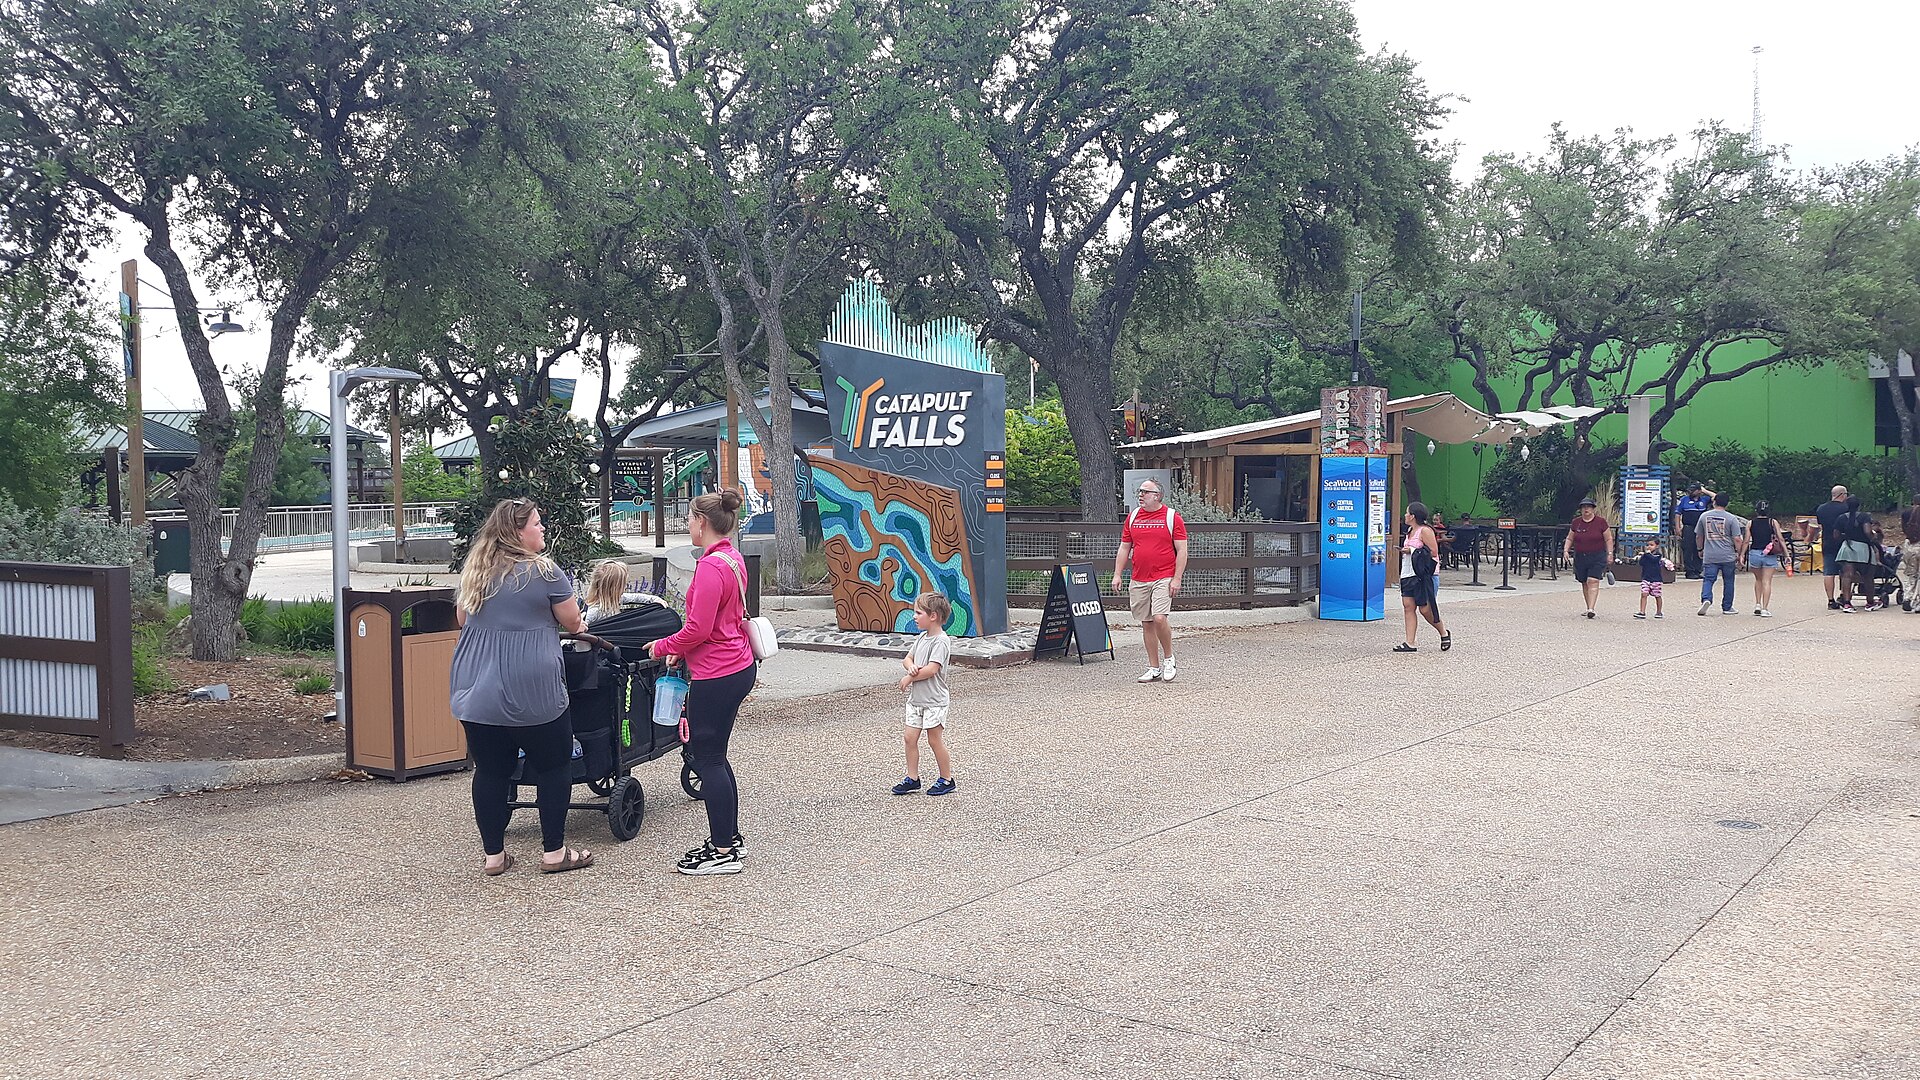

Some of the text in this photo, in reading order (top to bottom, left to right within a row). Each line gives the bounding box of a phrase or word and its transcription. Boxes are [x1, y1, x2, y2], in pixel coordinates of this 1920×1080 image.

[875, 391, 973, 415] CATAPULT
[868, 413, 967, 449] FALLS
[1335, 389, 1350, 450] AFRICA
[1323, 479, 1361, 487] SeaWorld
[1071, 600, 1102, 617] CLOSED
